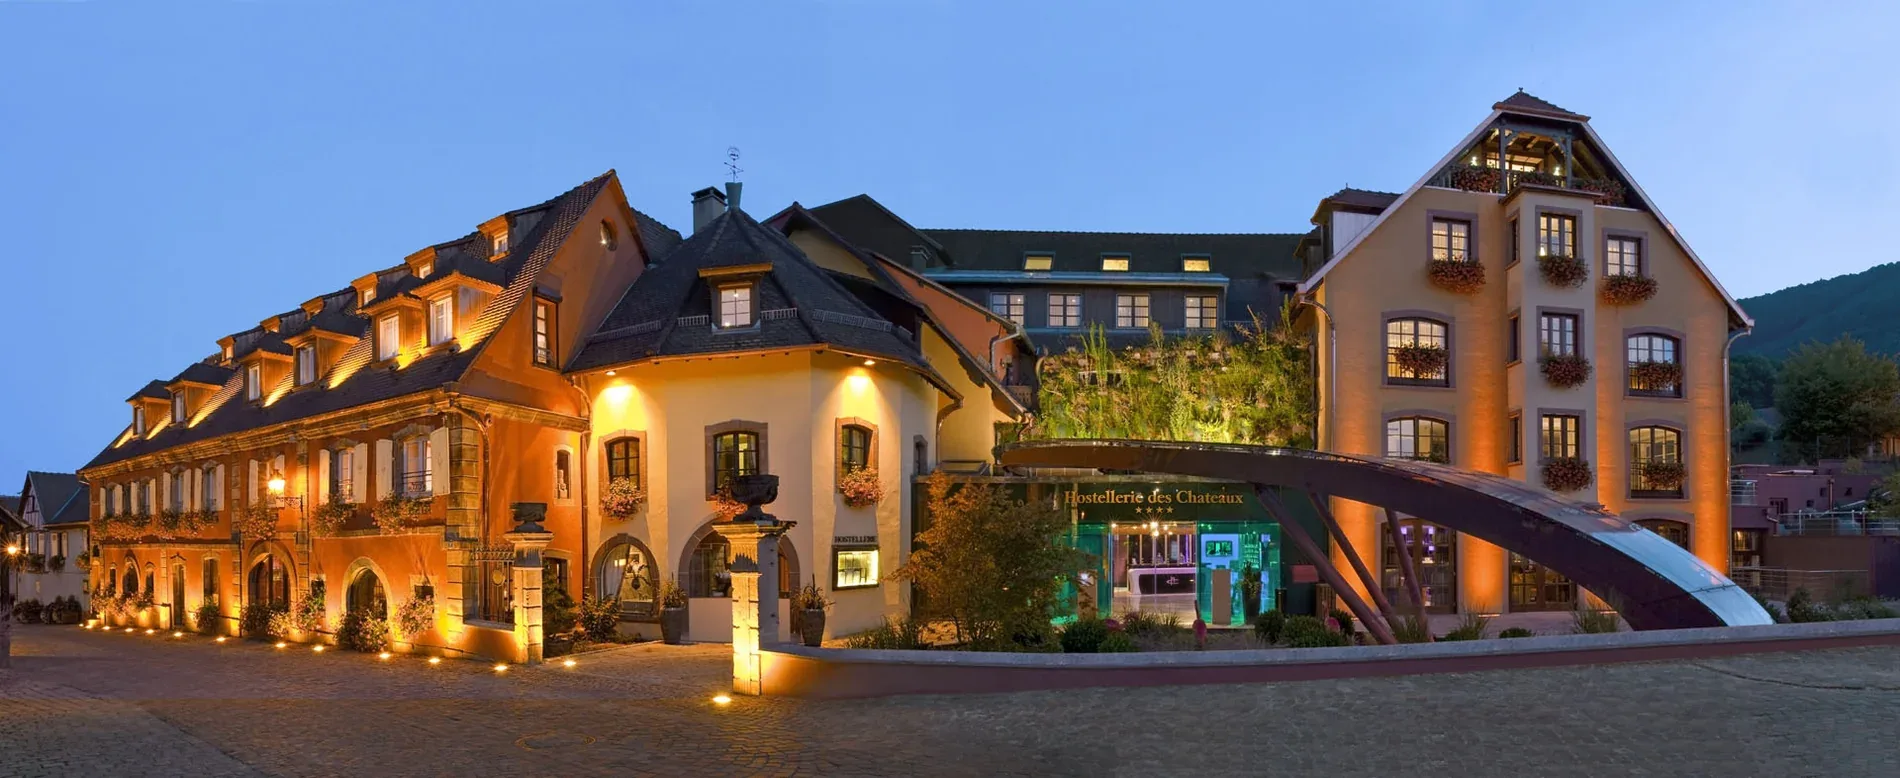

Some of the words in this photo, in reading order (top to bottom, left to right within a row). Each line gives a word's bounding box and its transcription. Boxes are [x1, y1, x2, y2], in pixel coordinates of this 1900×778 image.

[1064, 490, 1144, 504] Hostellerie
[1147, 489, 1172, 504] des
[1176, 490, 1243, 504] Chateaux
